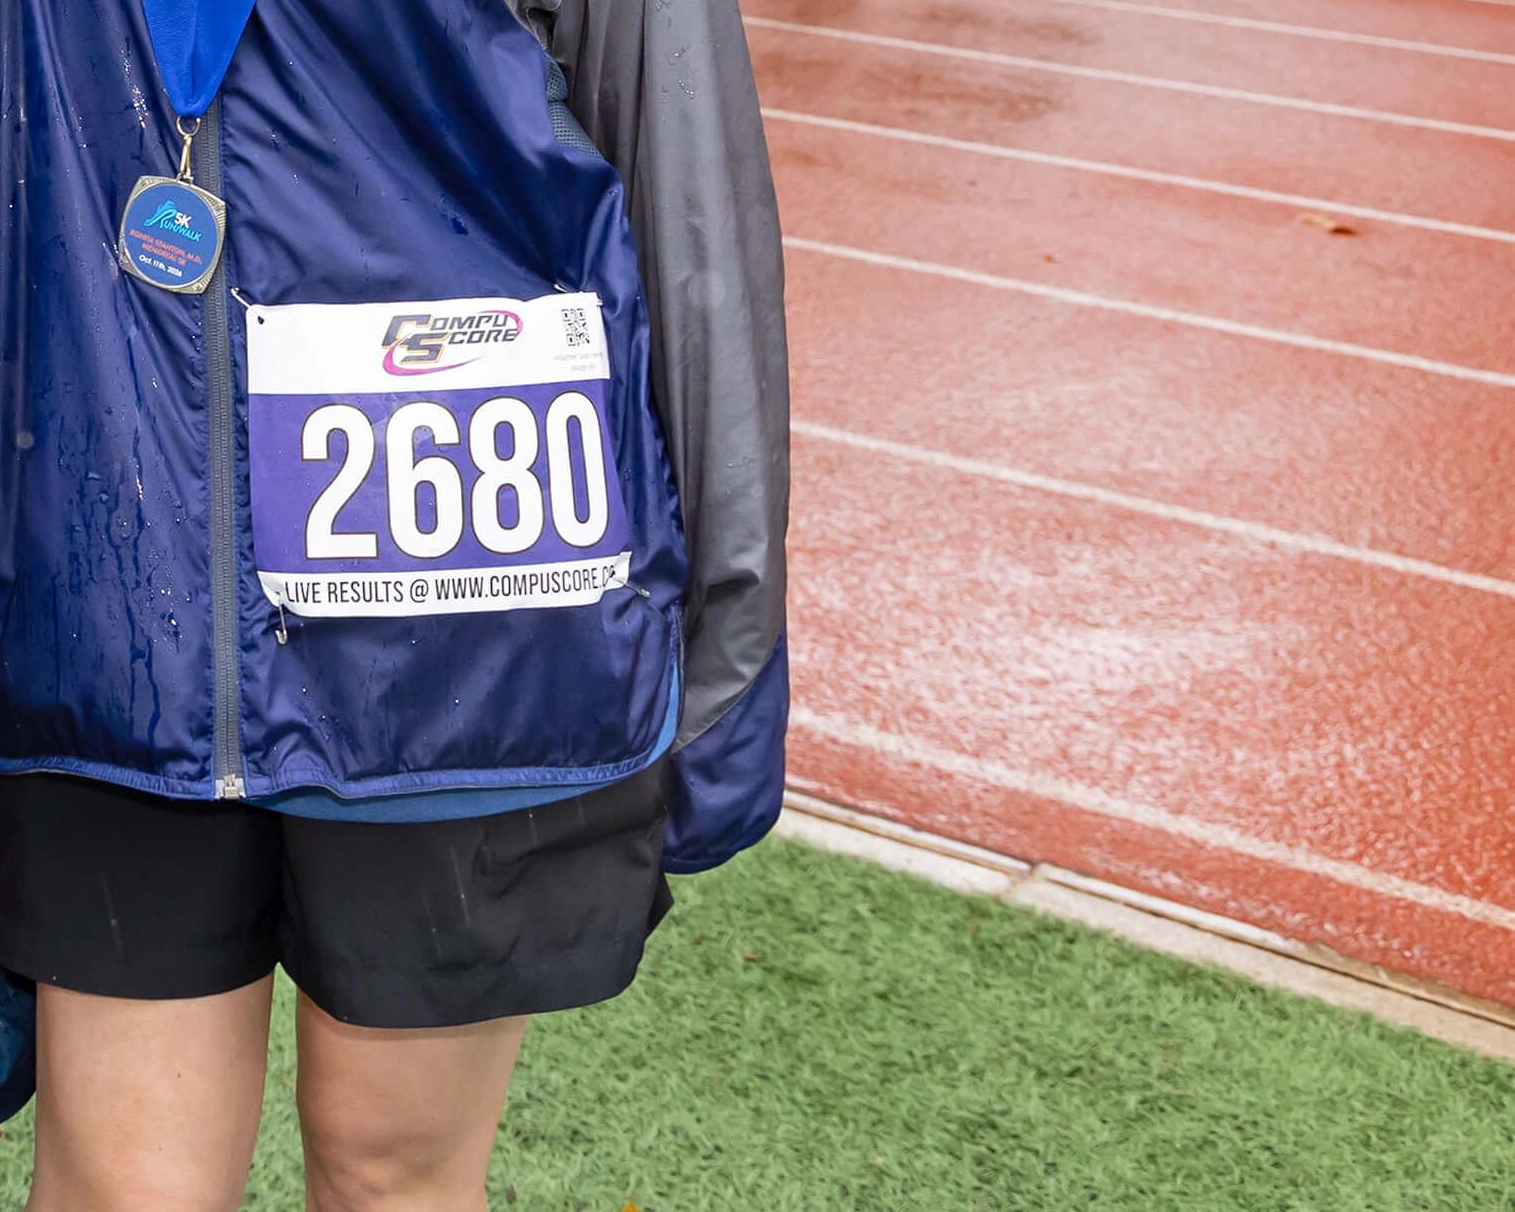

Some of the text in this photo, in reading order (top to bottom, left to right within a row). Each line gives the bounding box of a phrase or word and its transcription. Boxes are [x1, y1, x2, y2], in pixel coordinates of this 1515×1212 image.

[174, 212, 192, 228] 5K
[381, 313, 508, 348] COMPU
[399, 328, 518, 364] SCORE
[300, 390, 609, 560] 2680
[285, 581, 322, 604] LIVE
[327, 580, 404, 604] RESULTS
[409, 579, 430, 604] @
